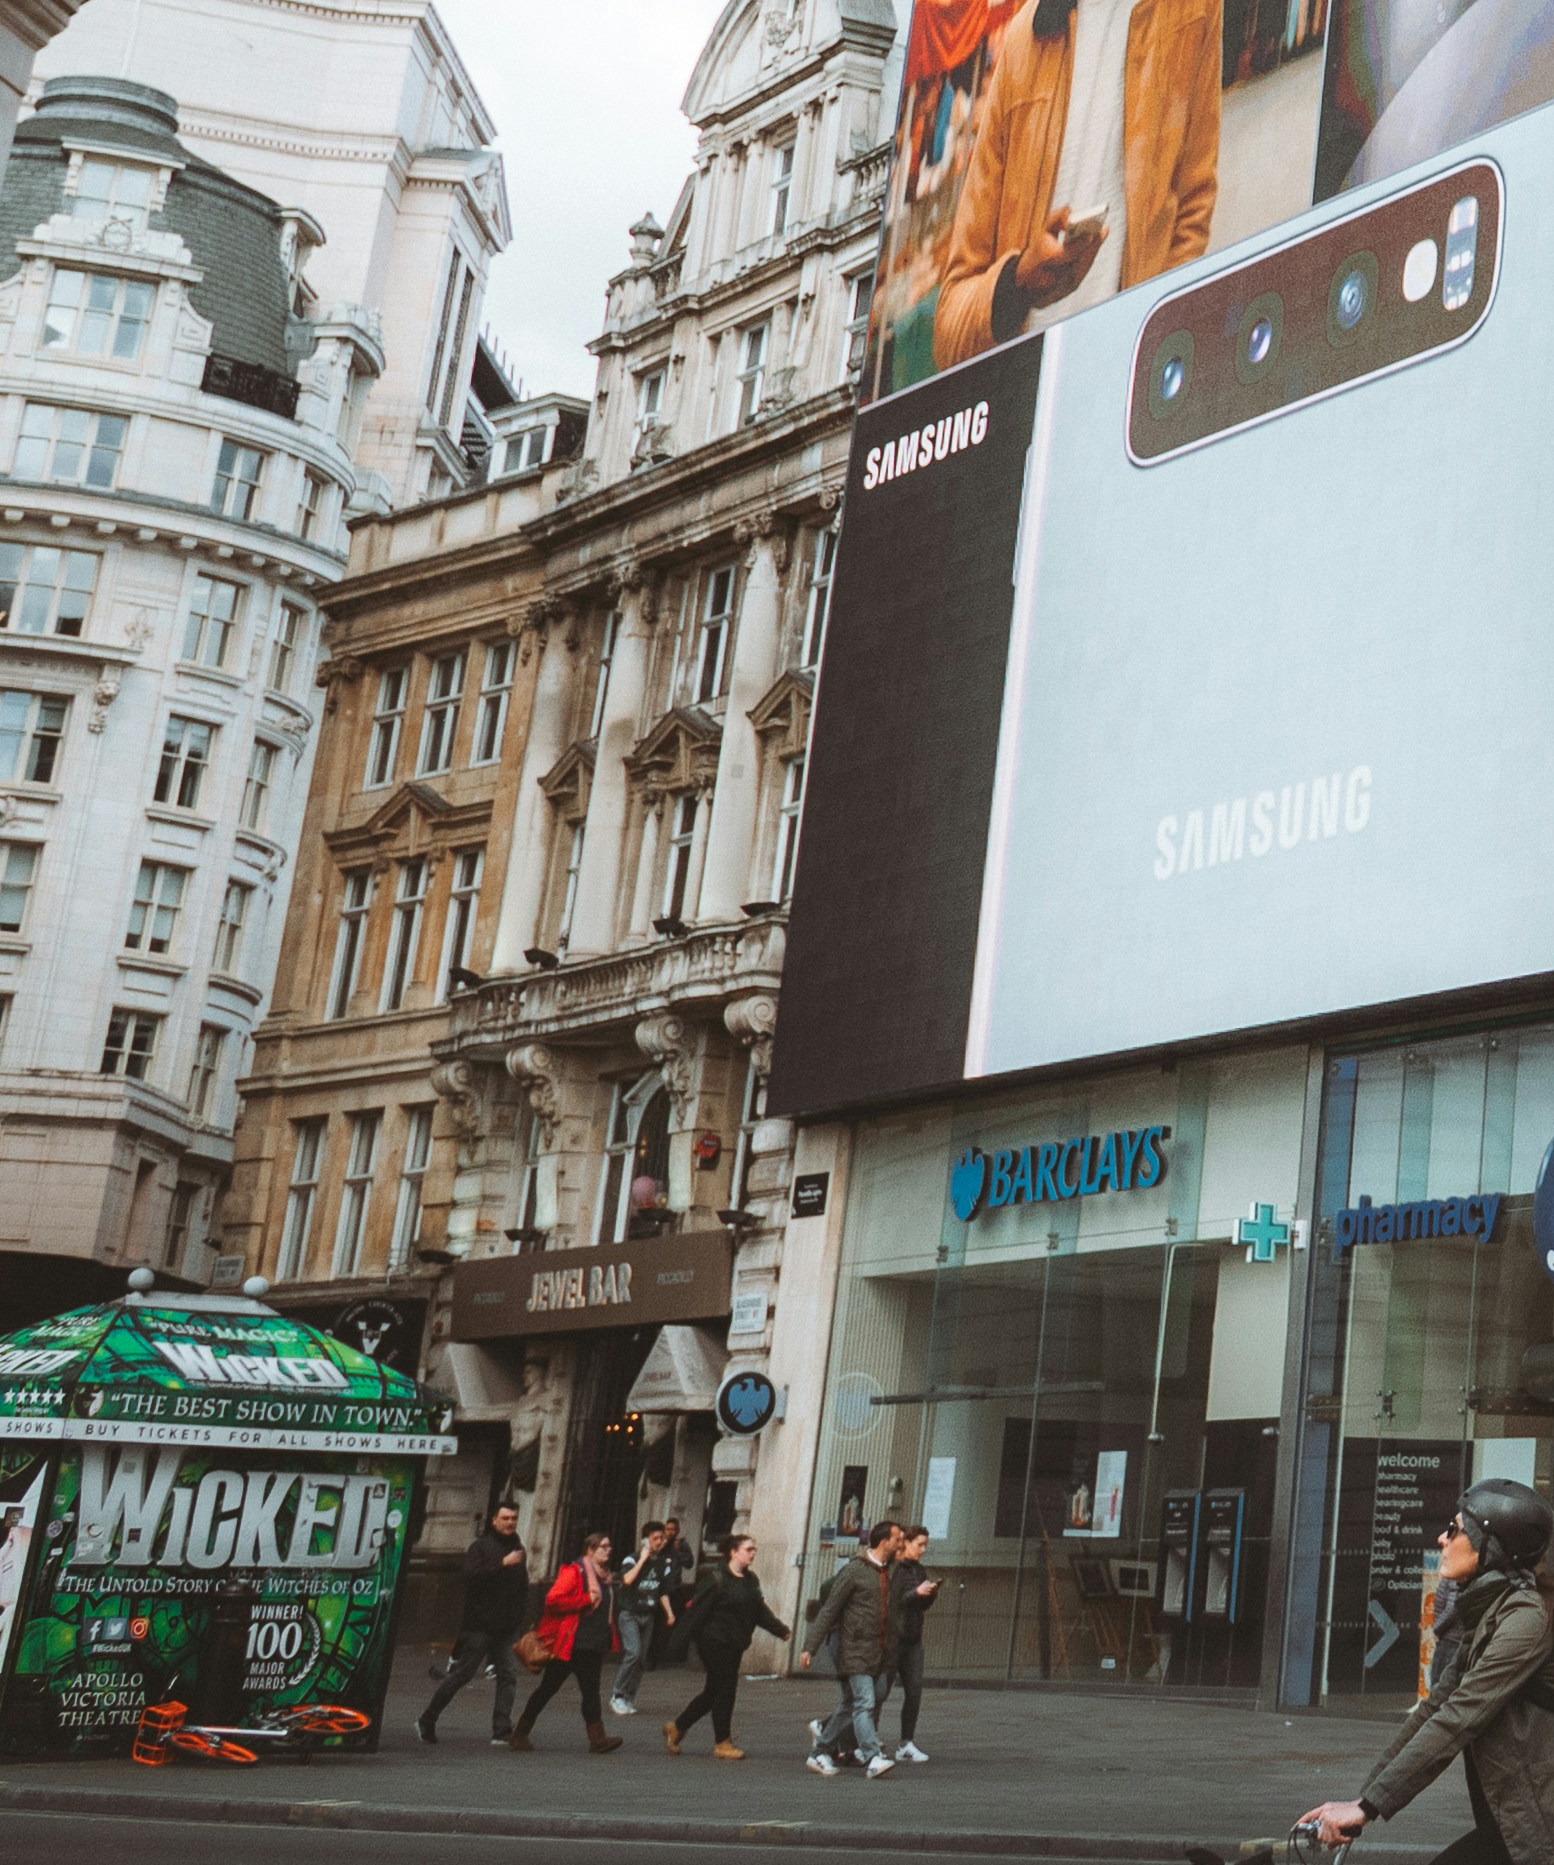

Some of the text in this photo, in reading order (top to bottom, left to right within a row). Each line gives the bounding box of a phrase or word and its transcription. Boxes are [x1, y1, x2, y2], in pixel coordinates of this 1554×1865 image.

[864, 400, 989, 490] SAMSUNG
[1153, 764, 1373, 881] SAMSUNG
[989, 1125, 1168, 1208] BARCLAYS
[1335, 1192, 1502, 1256] pharmacy
[526, 1262, 633, 1313] JEWEL BAR
[174, 1396, 232, 1419] BEST
[236, 1399, 307, 1423] SHOW
[311, 1404, 337, 1424] IN
[6, 1421, 53, 1433] SHOWS
[85, 1424, 438, 1451] BUY TICKETS FOR ALL SHOWS HERE
[1377, 1453, 1442, 1469] welcome
[251, 1604, 304, 1620] WINNER!
[245, 1622, 302, 1660] 100
[249, 1662, 286, 1675] MAJOR
[71, 1673, 144, 1689] APOLLO
[242, 1677, 287, 1690] AWARDS
[61, 1691, 147, 1708] VICTORIA
[58, 1709, 140, 1727] THEATRE
